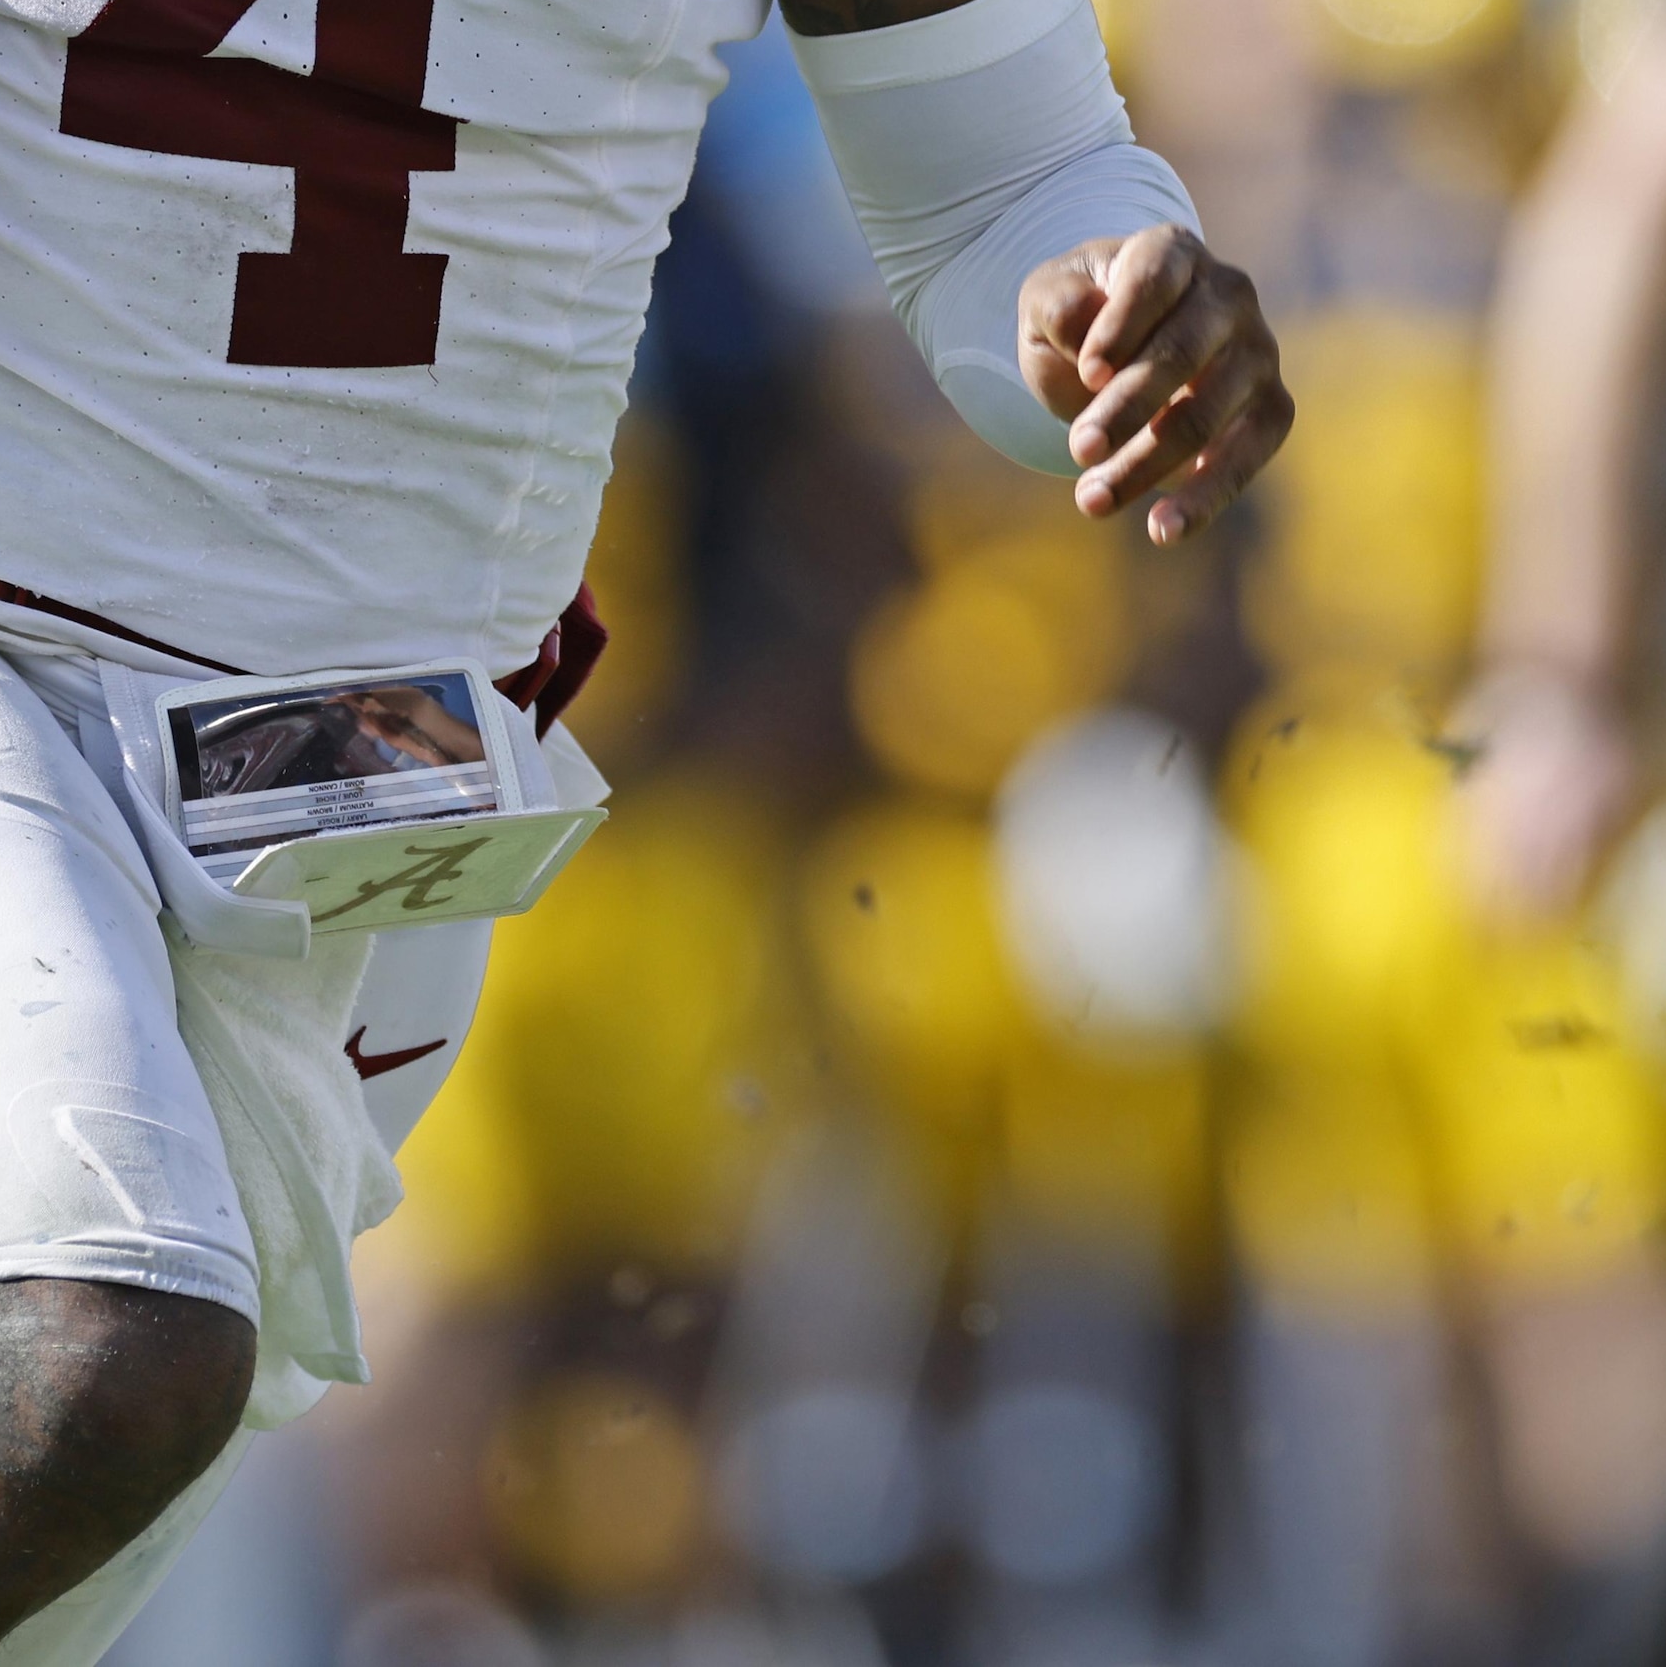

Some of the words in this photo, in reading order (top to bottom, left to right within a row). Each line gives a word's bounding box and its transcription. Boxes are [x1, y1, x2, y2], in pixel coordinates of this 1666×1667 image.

[344, 779, 365, 787] BOMB
[308, 783, 338, 792] CANNON
[339, 801, 374, 811] PLATINUM
[307, 808, 333, 816] BROWN
[347, 814, 368, 822] LARRY
[317, 818, 340, 827] ROGER
